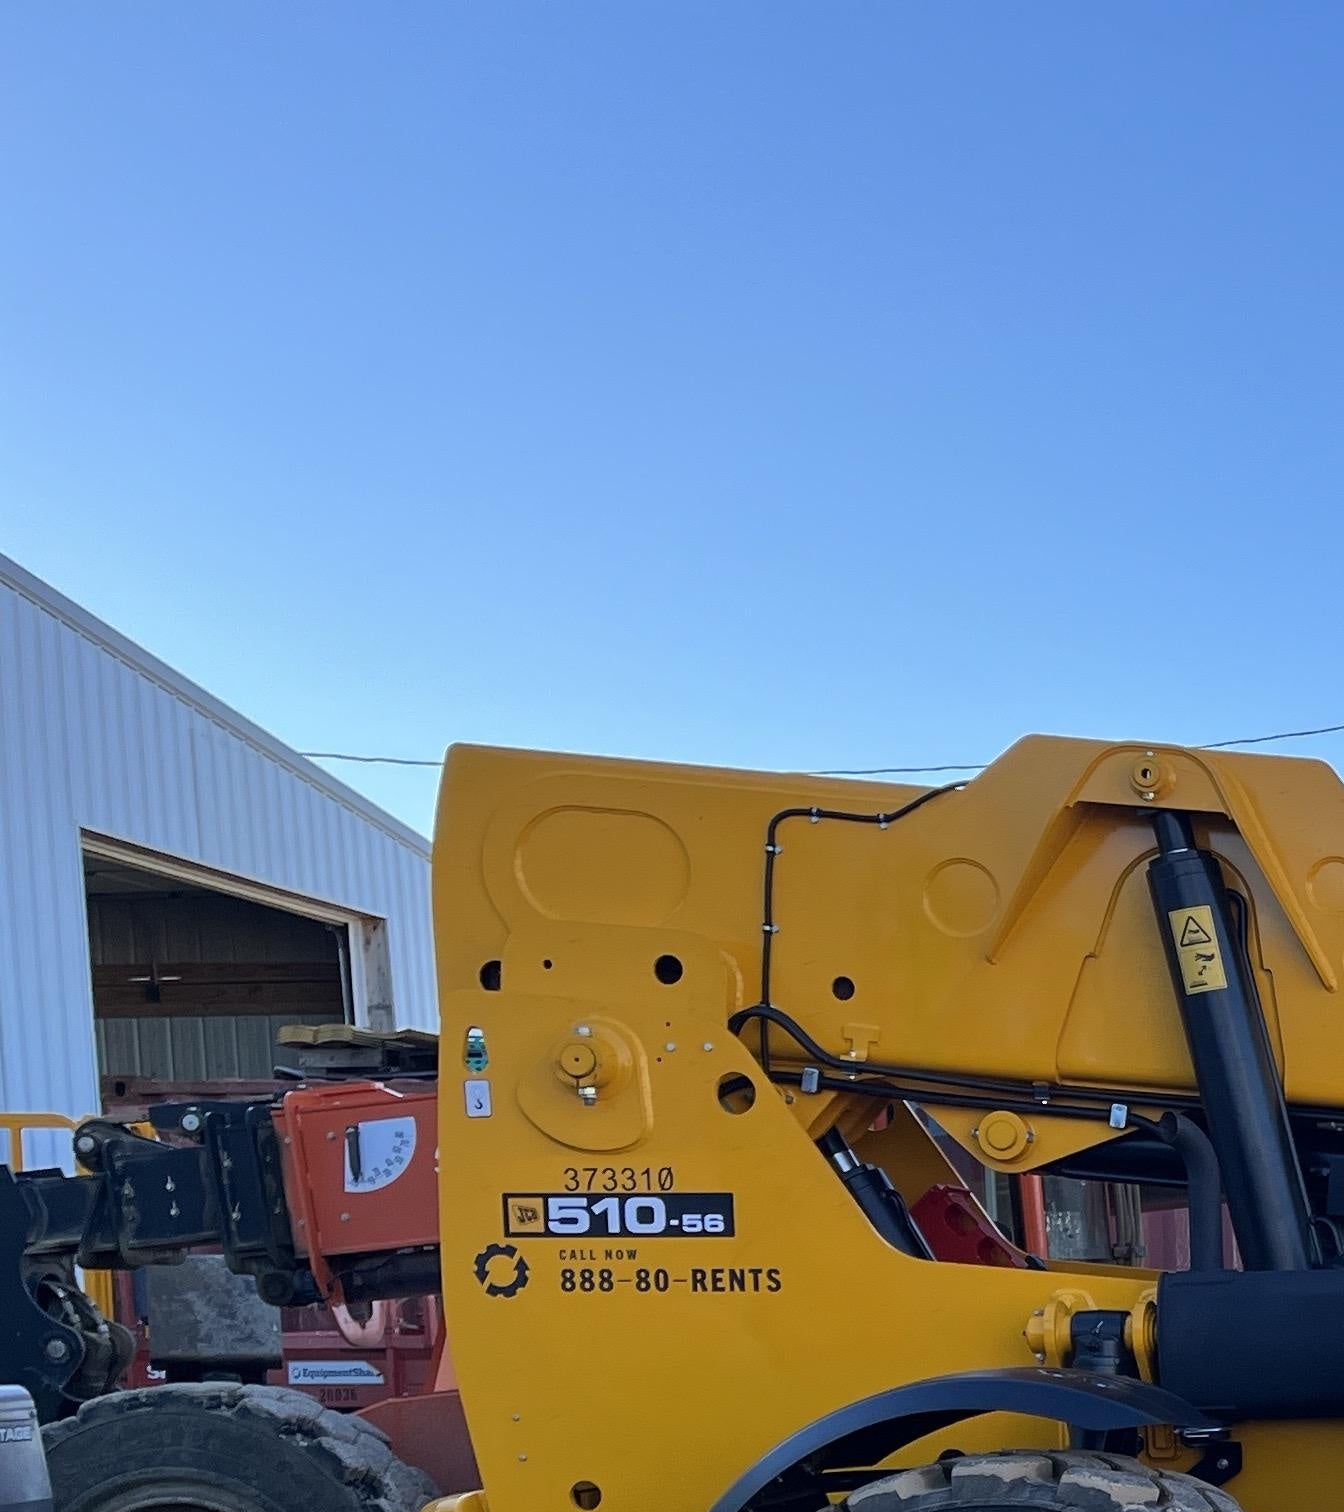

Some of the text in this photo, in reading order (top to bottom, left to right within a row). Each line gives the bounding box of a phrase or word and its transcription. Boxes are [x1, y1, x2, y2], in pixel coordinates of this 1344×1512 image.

[563, 1167, 674, 1191] 373310
[547, 1196, 725, 1234] 510-56
[559, 1249, 638, 1261] CALL NOW
[560, 1268, 782, 1293] 888-80-RENTS
